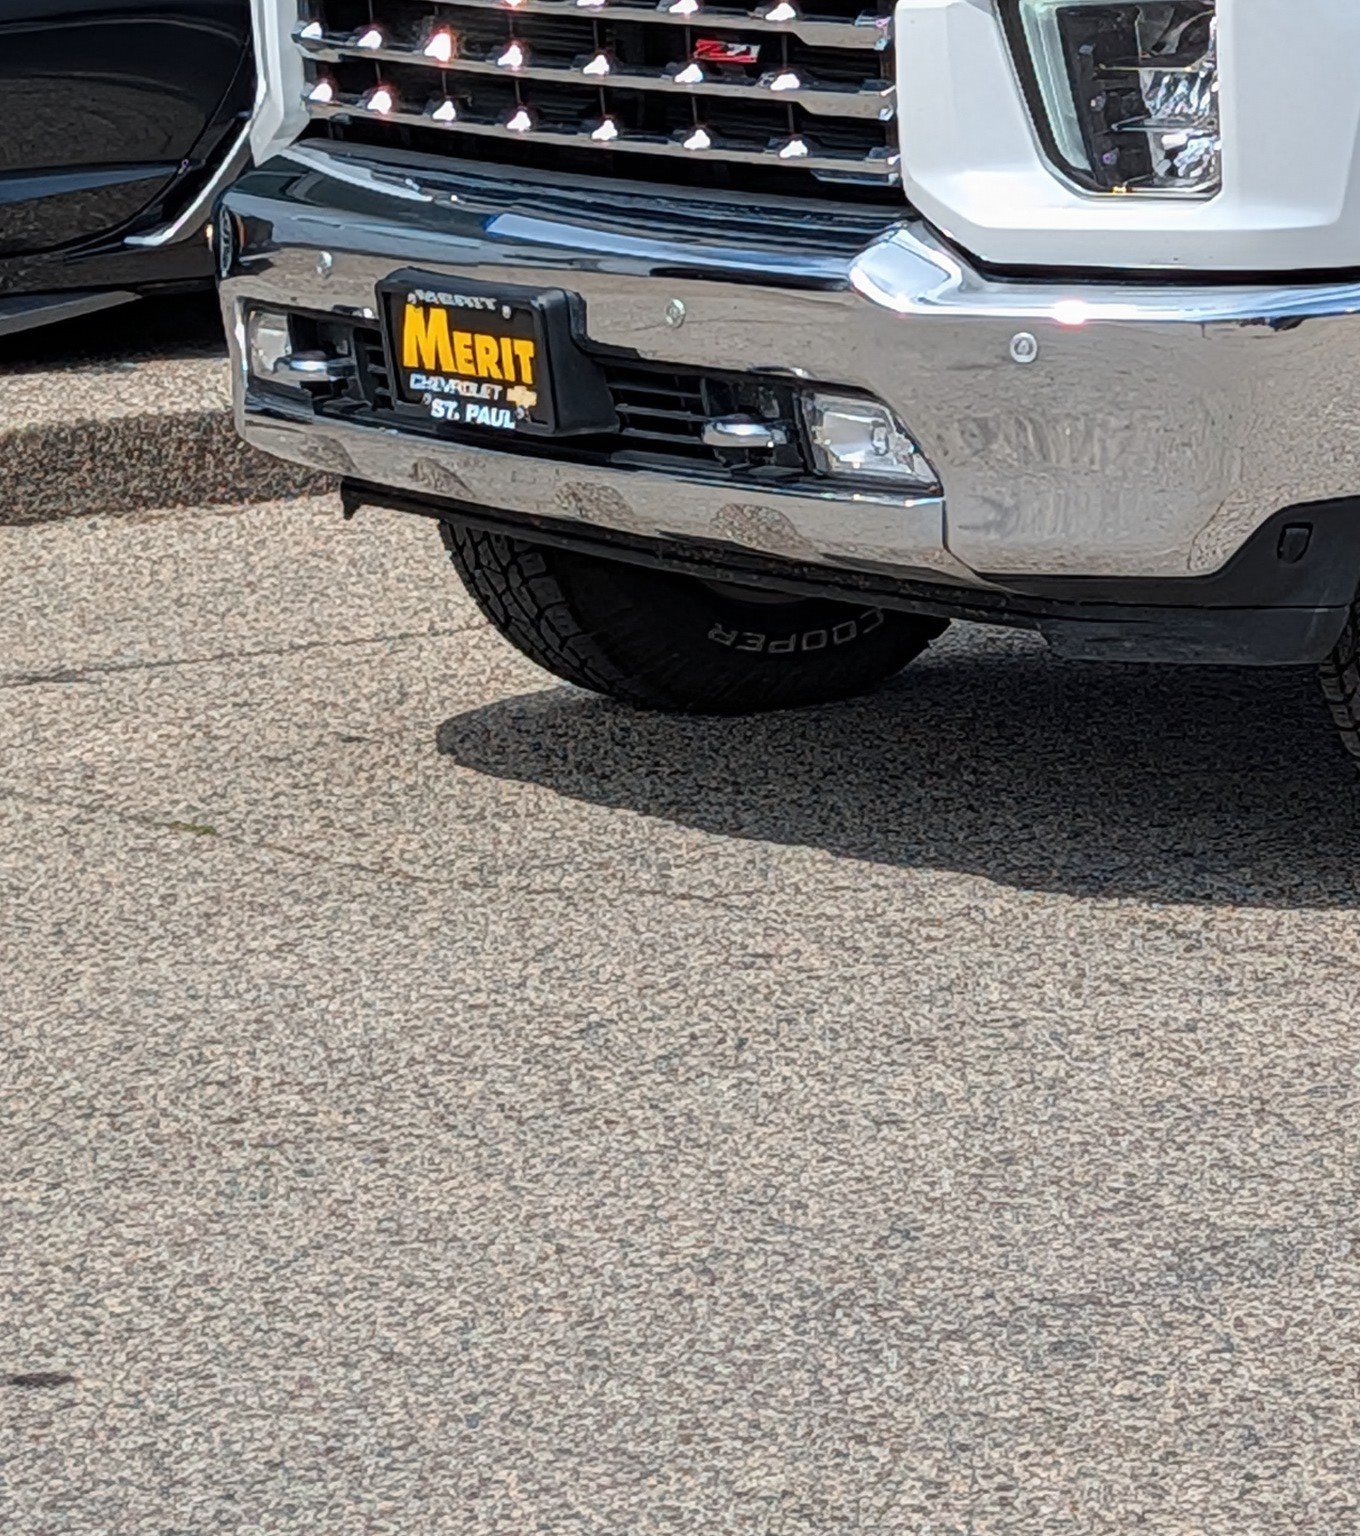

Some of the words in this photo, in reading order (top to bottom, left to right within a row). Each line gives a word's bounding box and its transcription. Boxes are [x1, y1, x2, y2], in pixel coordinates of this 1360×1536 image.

[403, 303, 535, 384] MERIT
[410, 372, 503, 401] CHEVROLET
[431, 398, 461, 421] ST.
[465, 403, 516, 430] PAUL
[706, 606, 885, 654] COOPER
